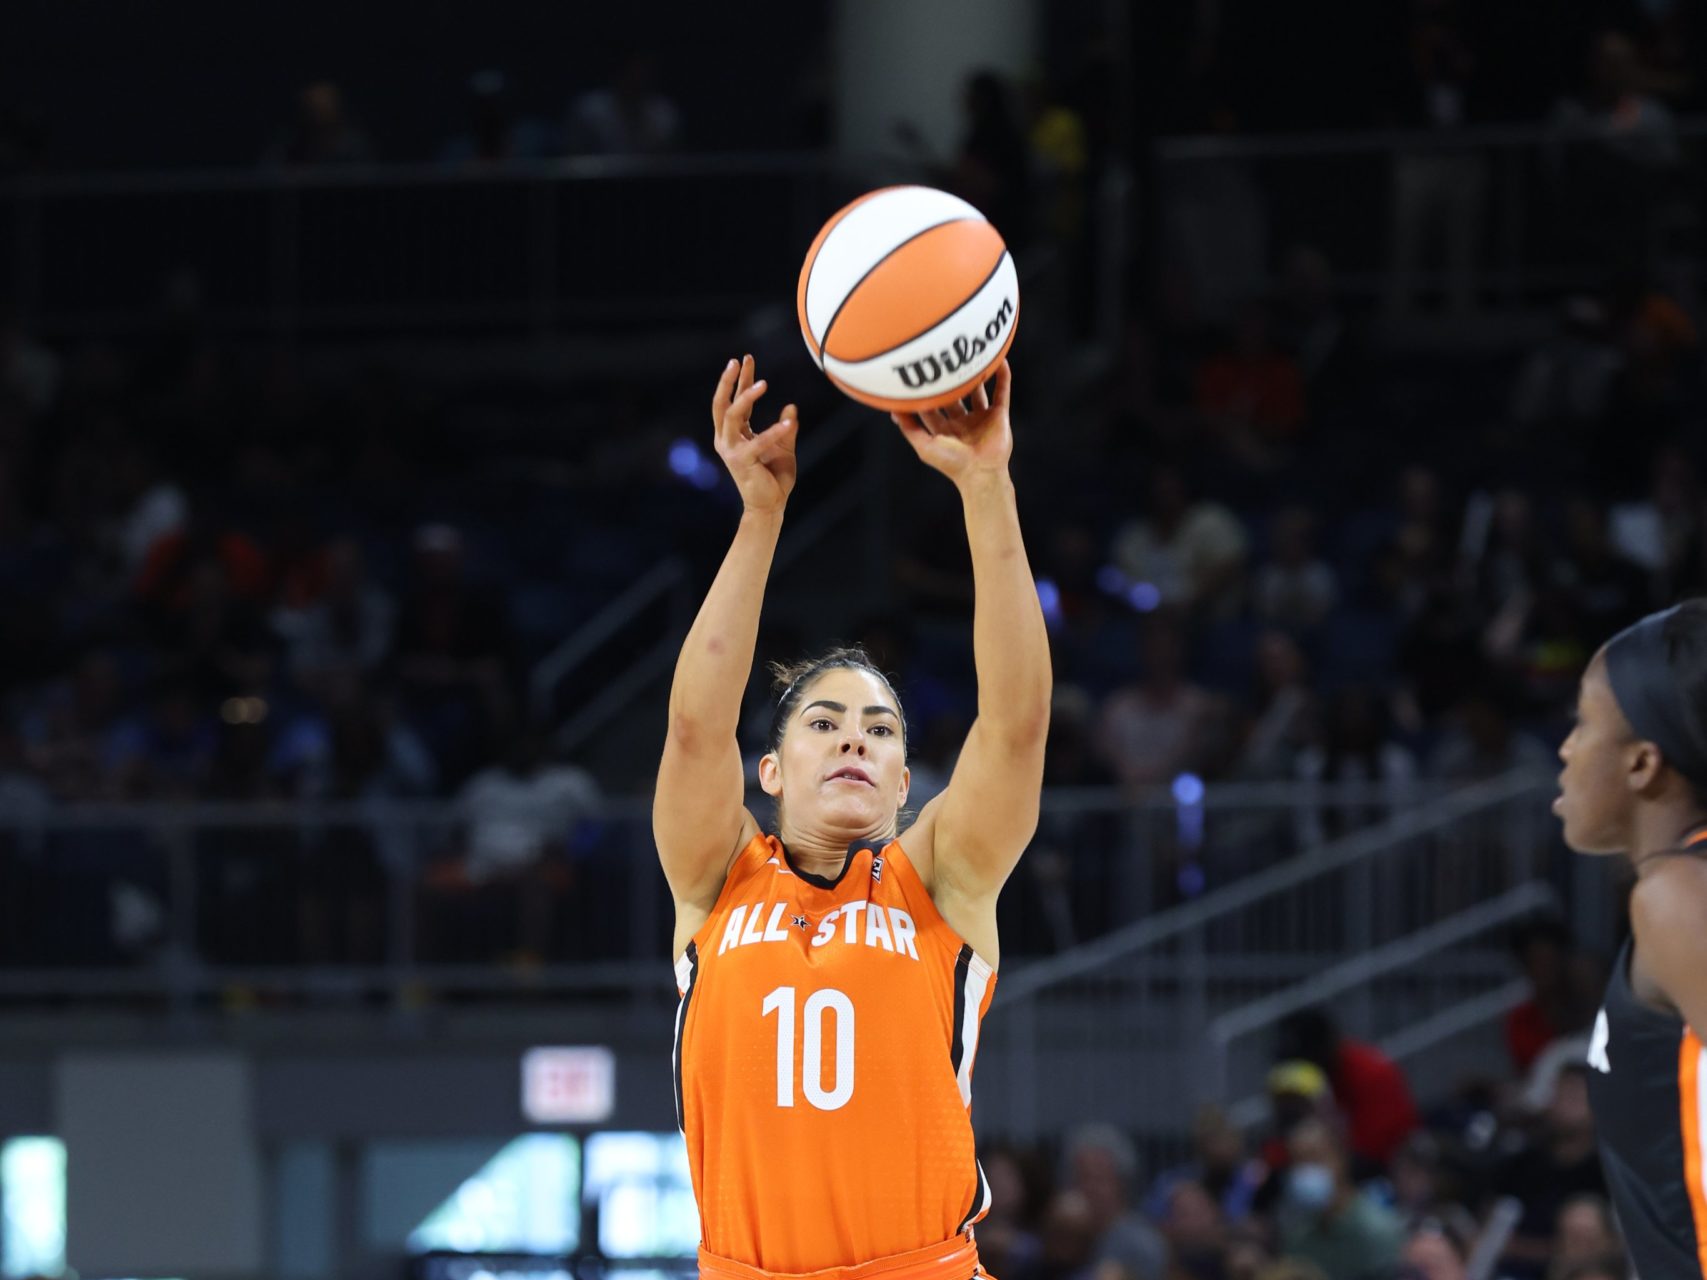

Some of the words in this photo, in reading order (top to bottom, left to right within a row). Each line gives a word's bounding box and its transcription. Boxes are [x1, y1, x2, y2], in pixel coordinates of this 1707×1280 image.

[893, 296, 1013, 389] Wilson
[718, 902, 789, 957] ALL
[811, 899, 920, 961] STAR
[762, 986, 855, 1111] 10
